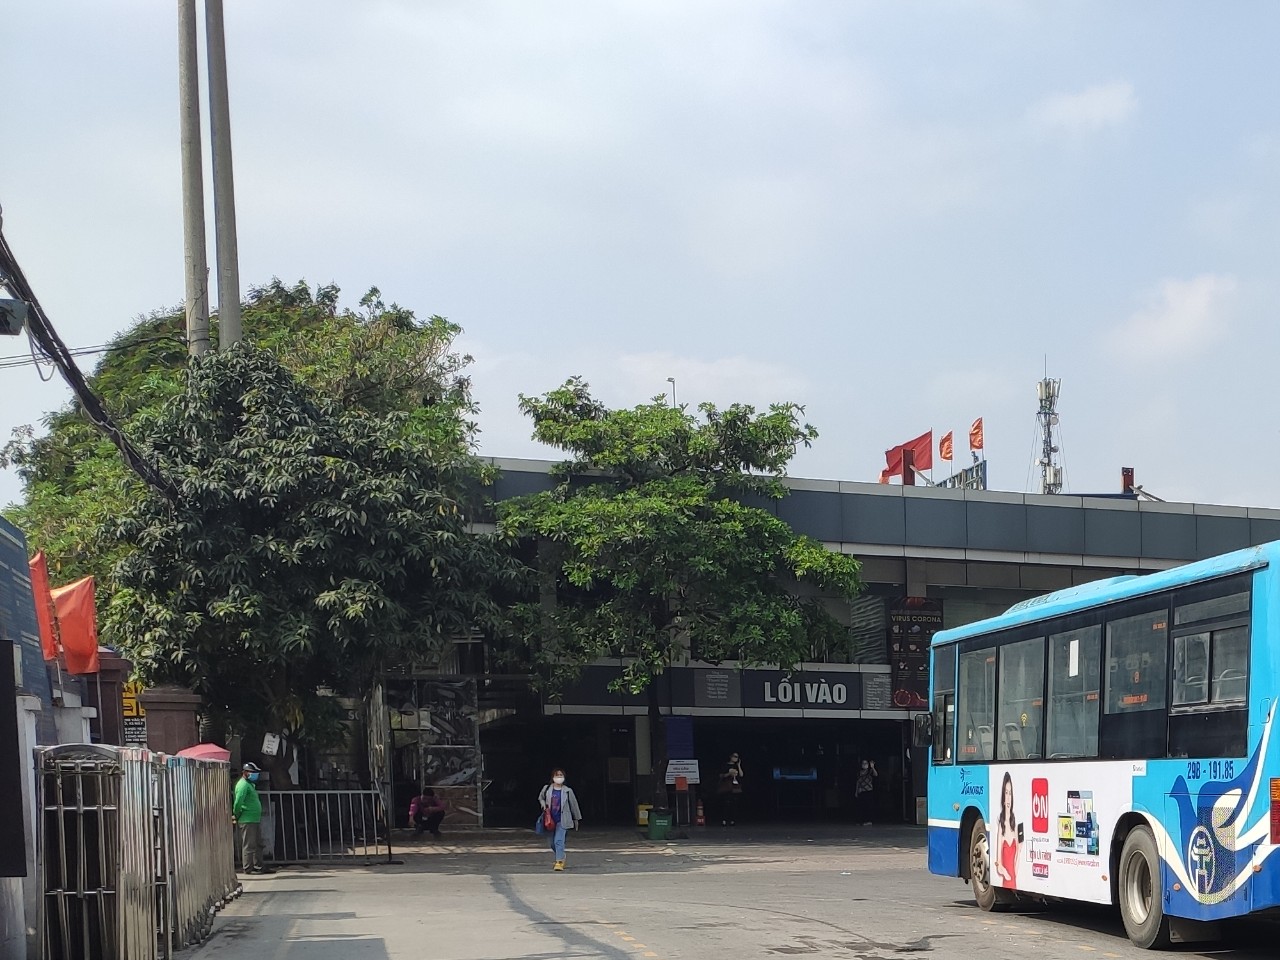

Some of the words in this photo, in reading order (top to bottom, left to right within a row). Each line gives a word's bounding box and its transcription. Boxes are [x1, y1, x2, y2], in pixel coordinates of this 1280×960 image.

[764, 671, 800, 703] LỐI
[805, 678, 847, 704] VÀO
[1187, 761, 1201, 780] 29B
[1208, 760, 1234, 780] 191.85
[1032, 792, 1048, 819] ON
